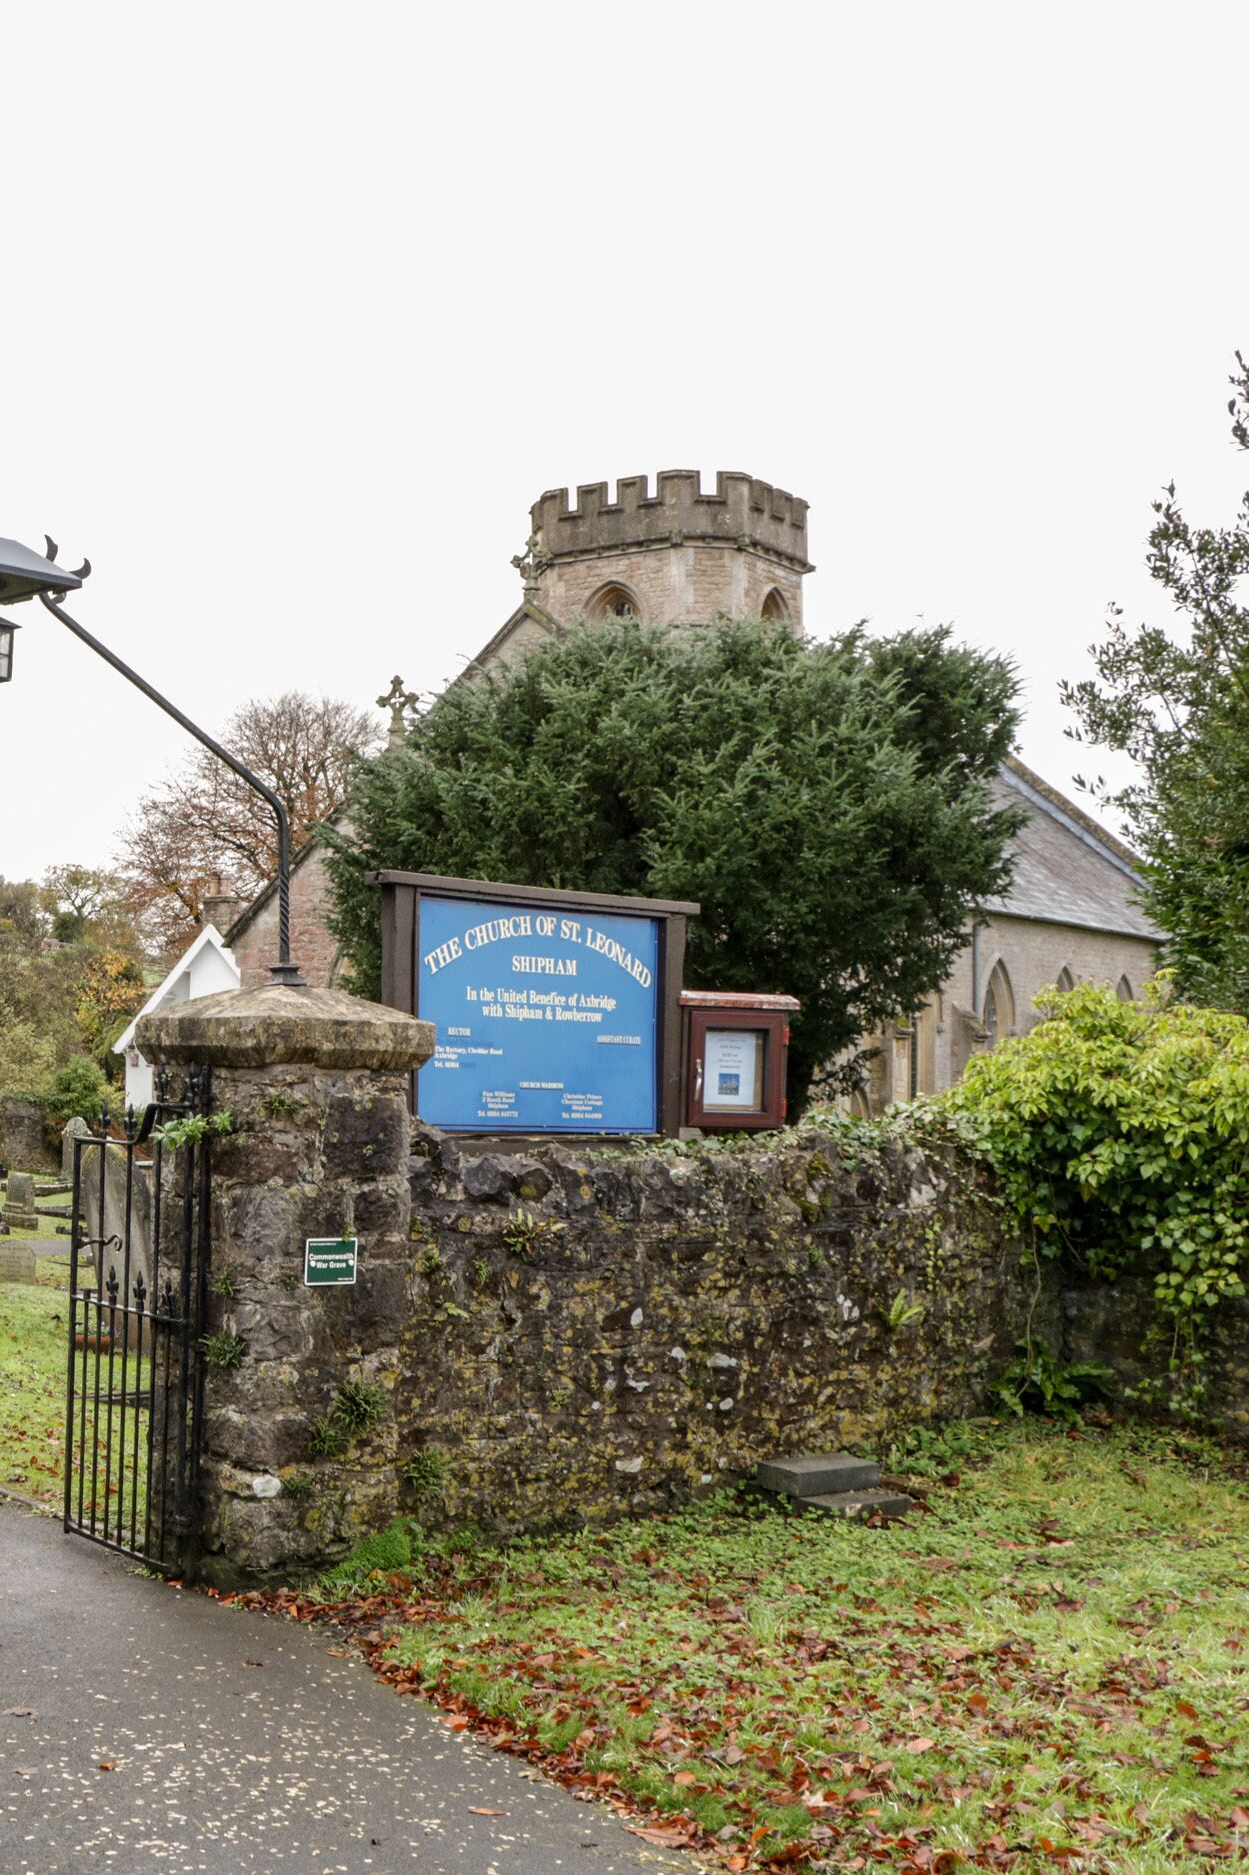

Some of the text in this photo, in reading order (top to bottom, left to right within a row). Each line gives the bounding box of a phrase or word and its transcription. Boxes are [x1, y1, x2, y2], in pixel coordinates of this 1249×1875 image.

[424, 915, 652, 989] THE CHURCH OF ST. LEONARD
[512, 955, 578, 975] SHIPHAM
[466, 986, 617, 1010] In the United Benefice of Axbridge
[482, 1003, 604, 1022] with Shipham & Rowberrow
[447, 1027, 471, 1036] RECTOR
[316, 1261, 347, 1269] War Grave
